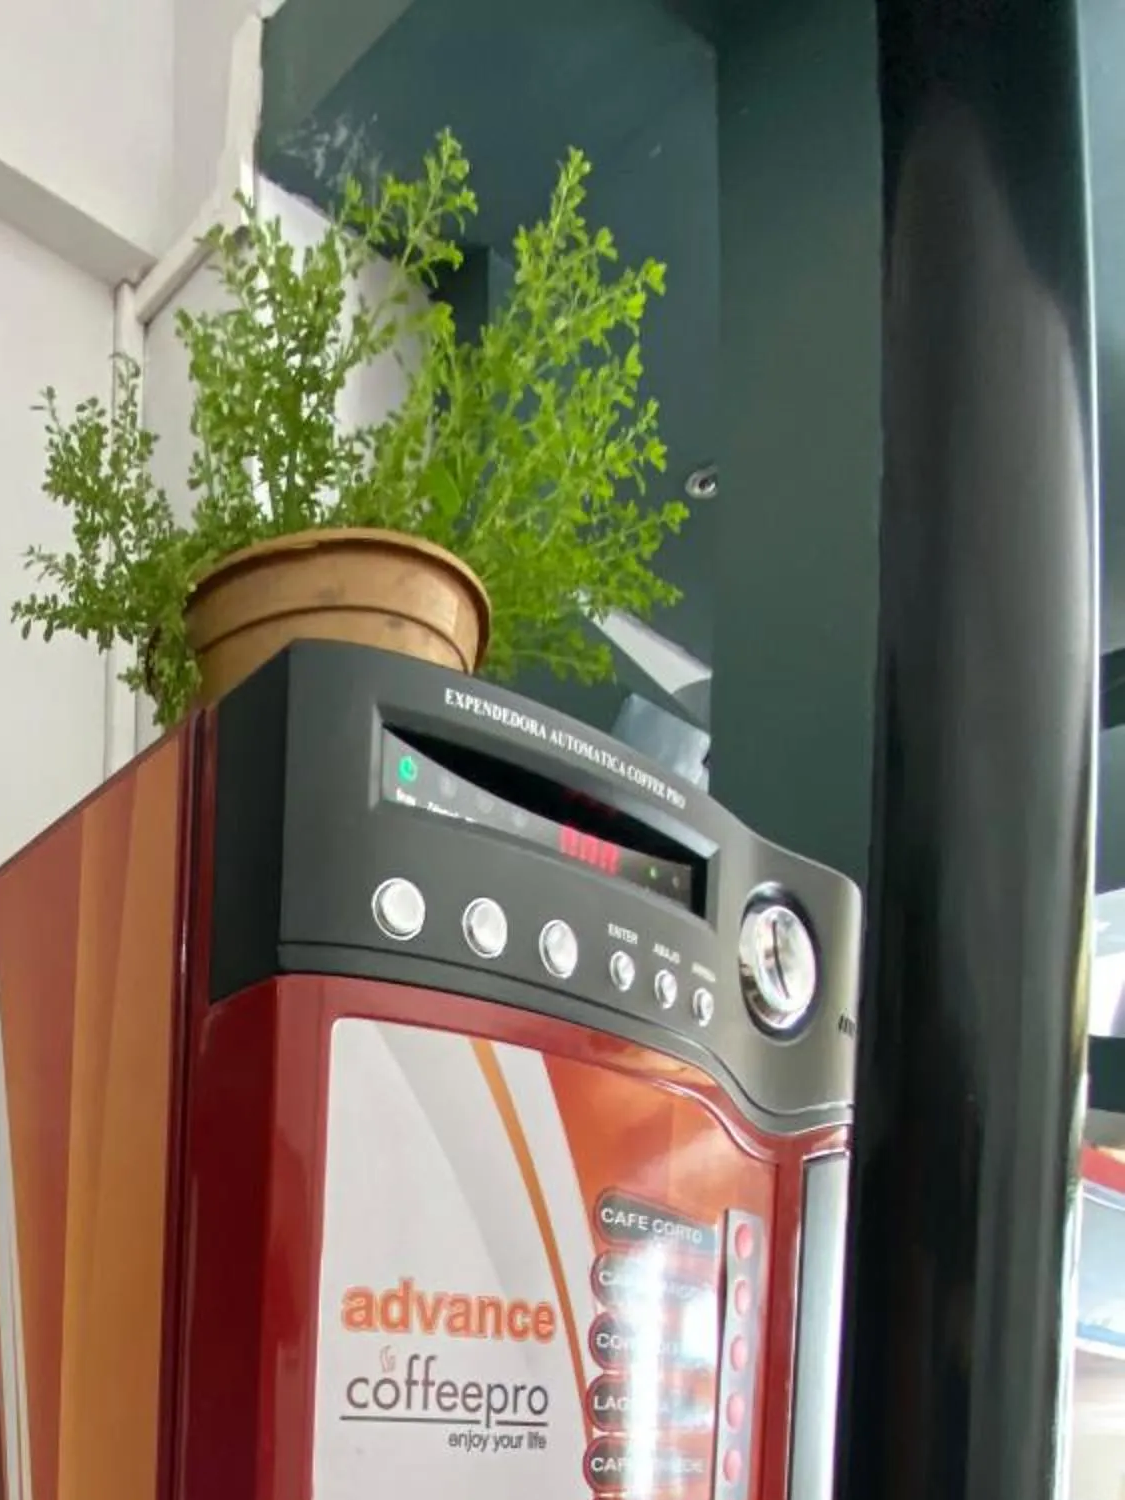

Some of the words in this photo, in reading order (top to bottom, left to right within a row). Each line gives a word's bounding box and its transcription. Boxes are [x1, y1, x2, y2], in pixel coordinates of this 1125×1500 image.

[444, 691, 547, 741] EXPENDEDORA
[549, 728, 627, 778] AUTOMATICA
[625, 764, 665, 796] COFFEE
[665, 784, 687, 811] PRO
[608, 922, 638, 945] ENTER
[600, 1207, 649, 1231] CAFE
[651, 1218, 703, 1245] CORTO
[342, 1276, 556, 1343] advance
[345, 1353, 550, 1428] coffeepro
[448, 1428, 490, 1453] enjoy
[493, 1432, 523, 1453] your
[527, 1430, 547, 1450] life
